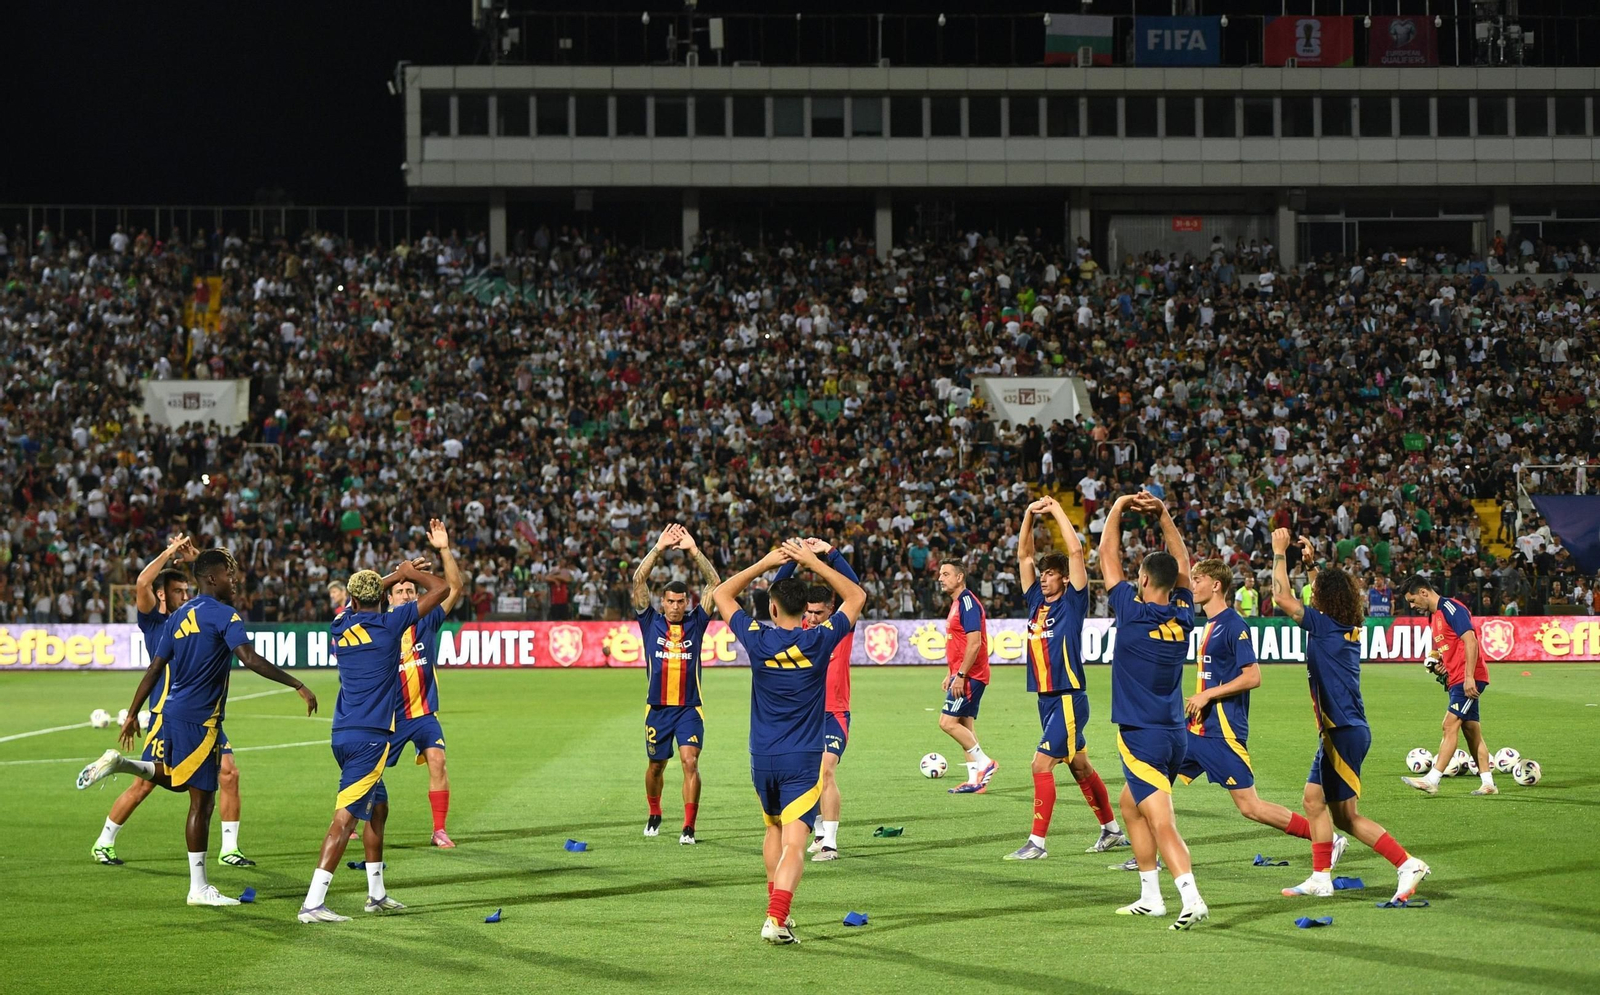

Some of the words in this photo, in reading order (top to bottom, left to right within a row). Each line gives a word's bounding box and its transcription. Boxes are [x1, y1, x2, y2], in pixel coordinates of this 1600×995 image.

[1147, 29, 1207, 51] FIFA
[1381, 56, 1426, 64] QUALIFIERS
[1020, 393, 1035, 404] 14
[655, 650, 693, 660] MAPFRE
[150, 737, 164, 759] 18
